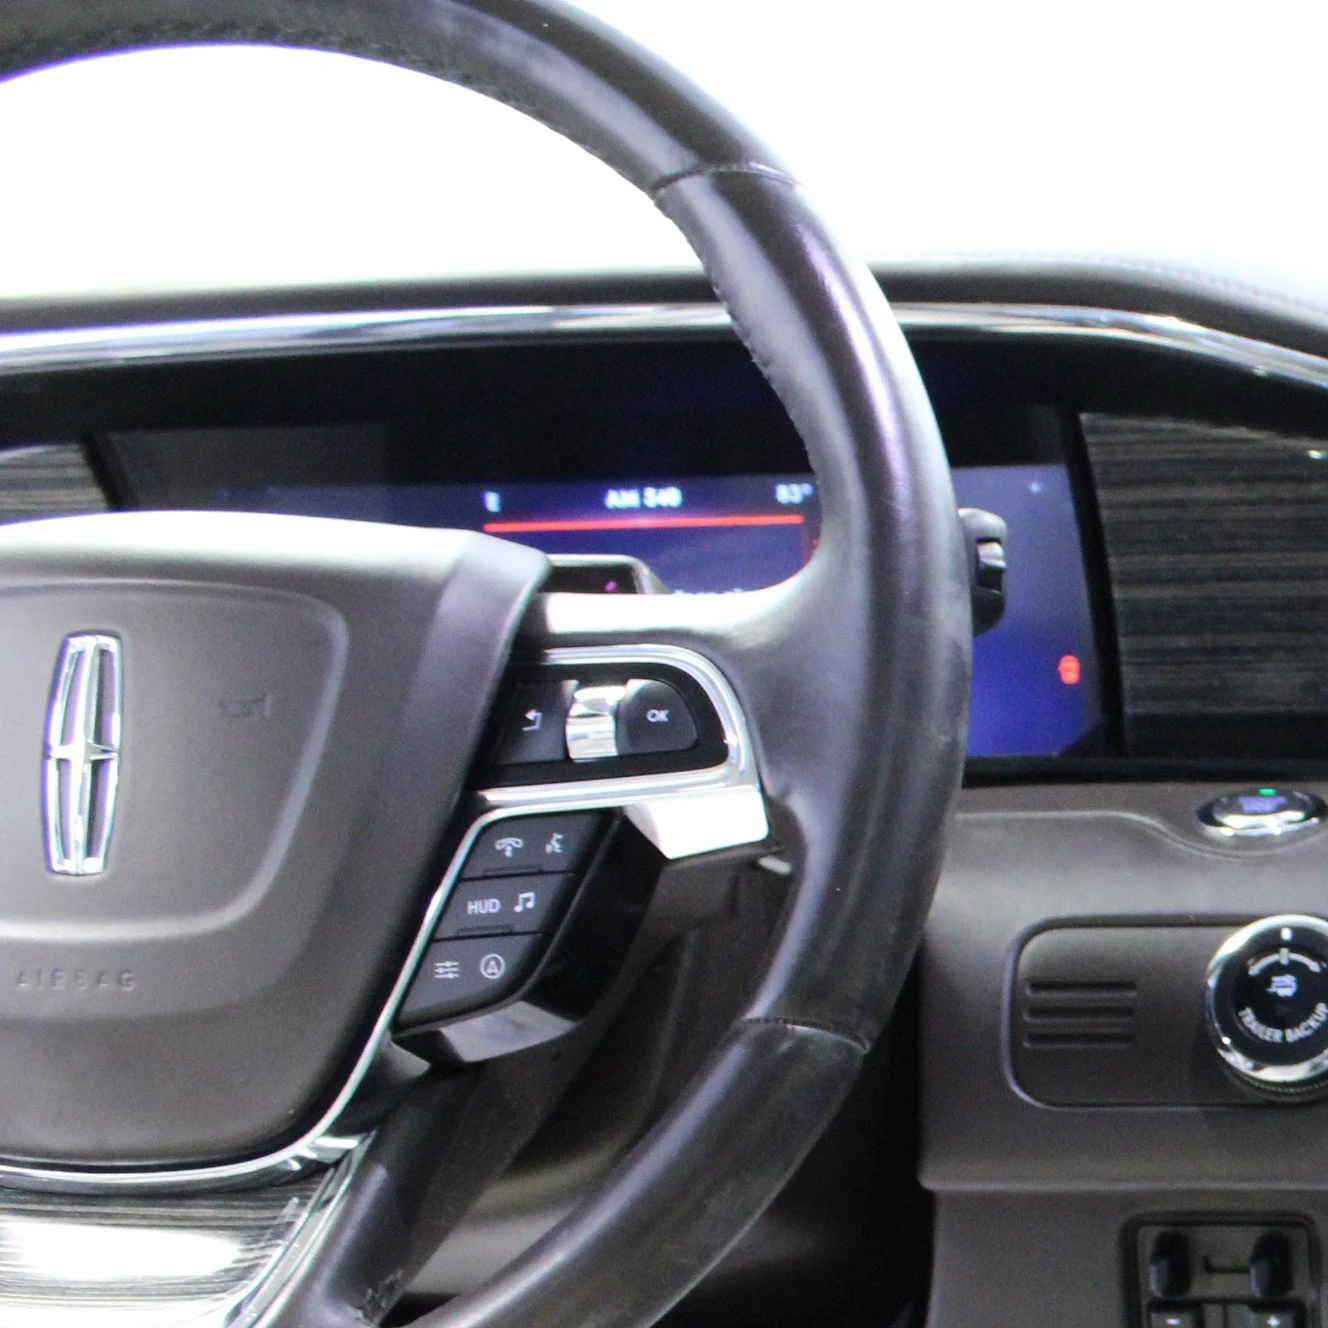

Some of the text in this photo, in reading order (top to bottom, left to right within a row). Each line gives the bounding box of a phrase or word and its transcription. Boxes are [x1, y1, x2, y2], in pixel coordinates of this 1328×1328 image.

[605, 490, 640, 508] AM
[647, 709, 668, 722] OK
[467, 899, 500, 914] HUD
[1285, 1003, 1328, 1042] BACKUP
